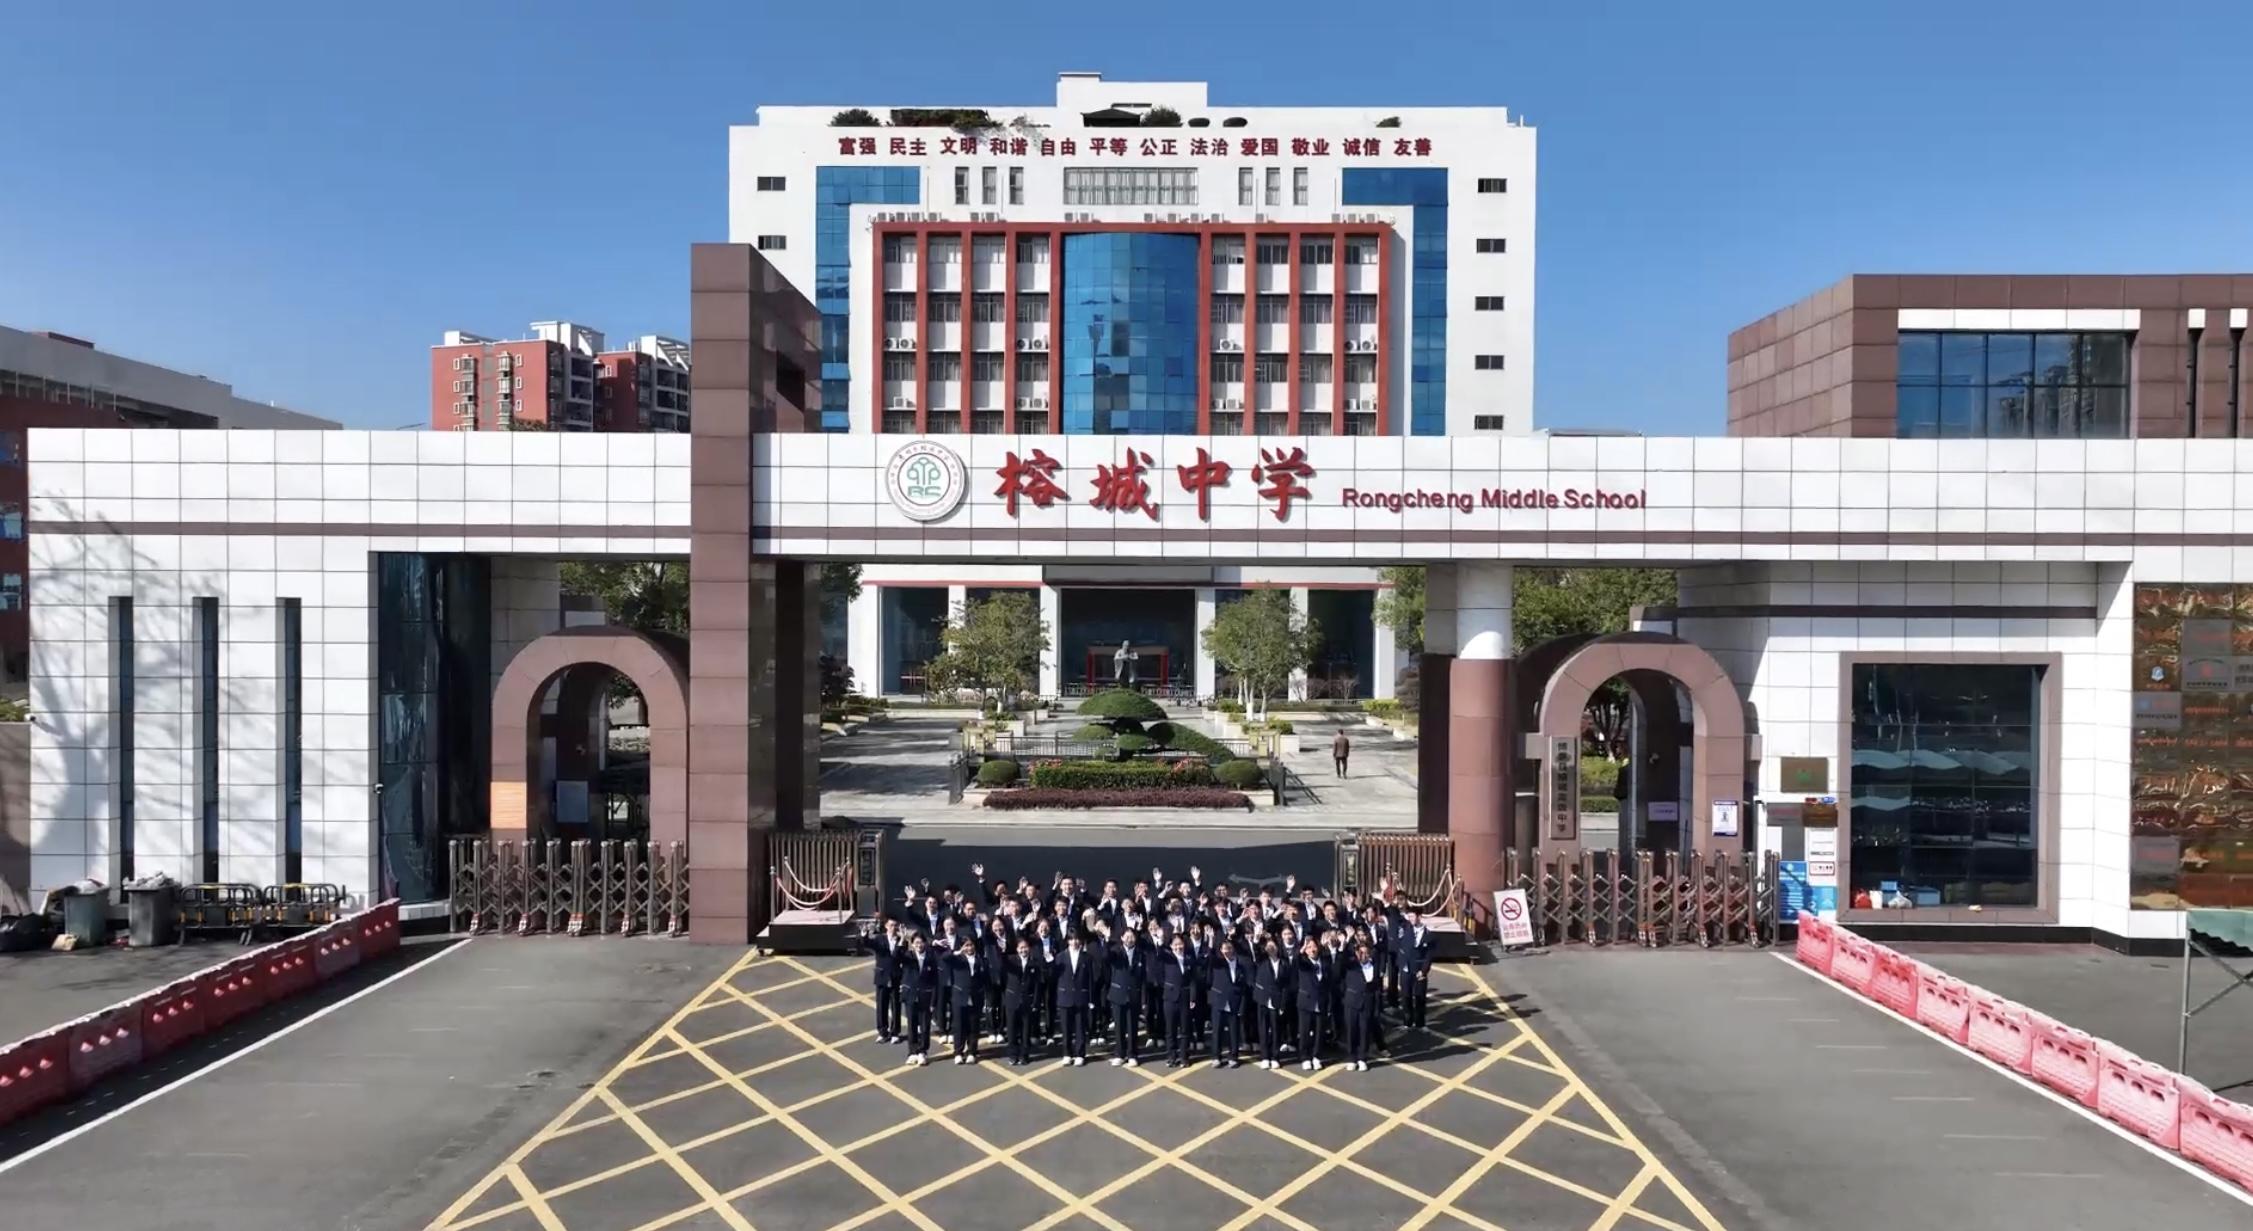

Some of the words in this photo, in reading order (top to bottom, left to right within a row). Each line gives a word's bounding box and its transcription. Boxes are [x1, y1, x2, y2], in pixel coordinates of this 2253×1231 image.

[838, 137, 877, 156] 富强
[889, 137, 928, 156] 民主
[940, 136, 978, 156] 文明
[989, 137, 1029, 156] 和谐
[1040, 137, 1077, 156] 自由
[1089, 137, 1128, 156] 平等
[1139, 138, 1178, 157] 公正
[1189, 138, 1230, 157] 法治
[1240, 138, 1279, 157] 爱国
[1291, 138, 1330, 157] 敬业
[1342, 138, 1381, 157] 诚信
[1393, 138, 1432, 157] 友善
[906, 485, 942, 497] RC
[994, 446, 1315, 522] 榕城中学
[1341, 488, 1473, 514] Rongcheng
[1480, 487, 1559, 509] Middle
[1564, 487, 1646, 510] School
